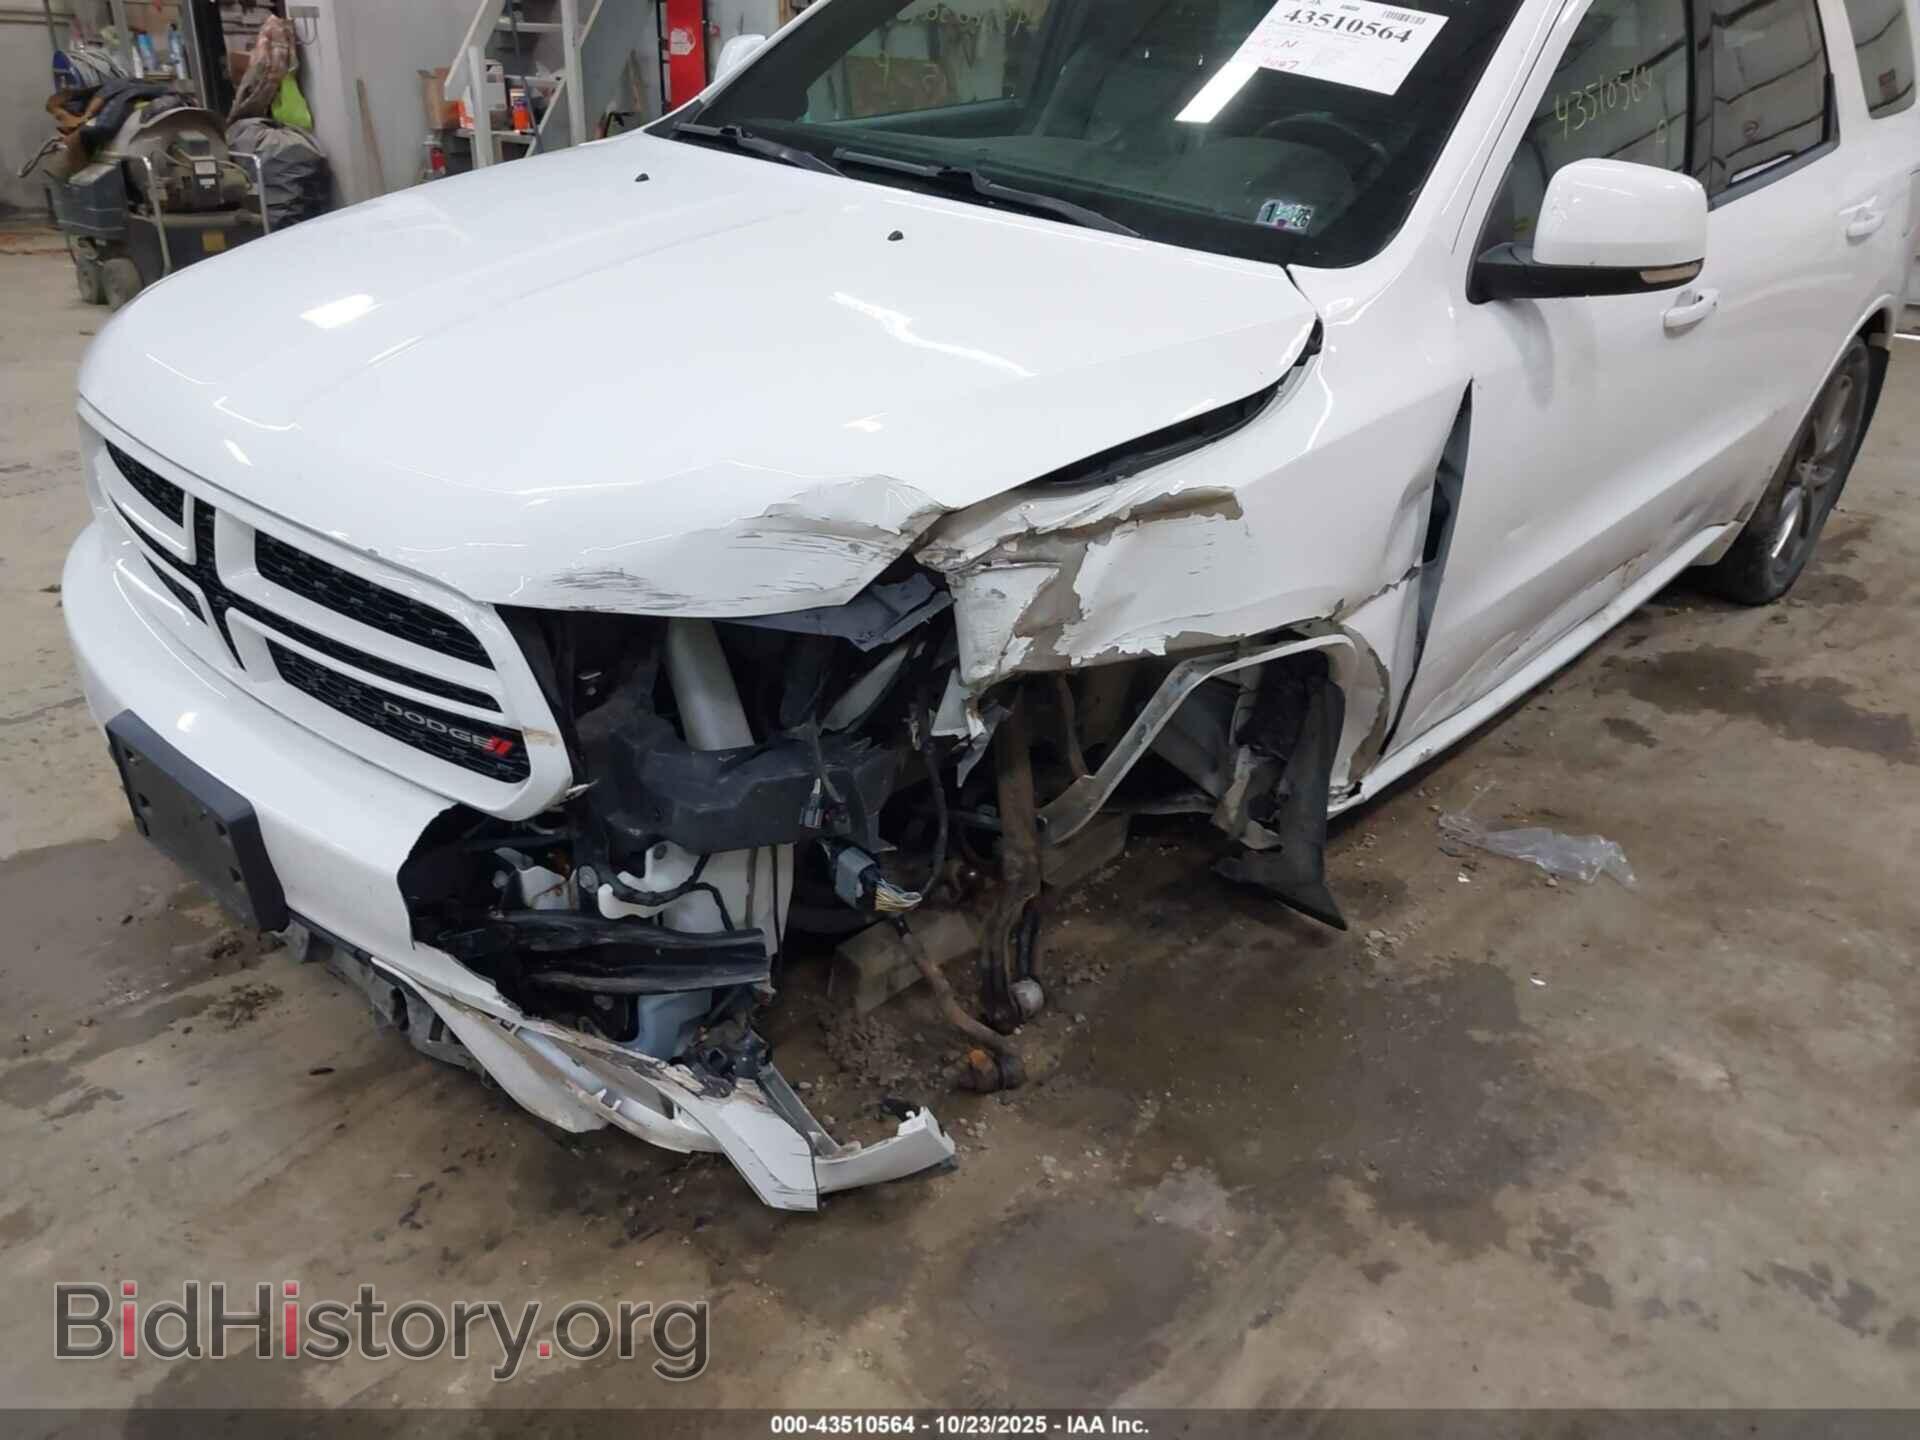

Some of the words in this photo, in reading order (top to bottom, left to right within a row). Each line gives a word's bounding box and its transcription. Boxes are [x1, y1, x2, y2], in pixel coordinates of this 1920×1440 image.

[1284, 8, 1413, 43] 43510564
[1555, 64, 1653, 140] 43510564
[384, 701, 495, 751] DODGE
